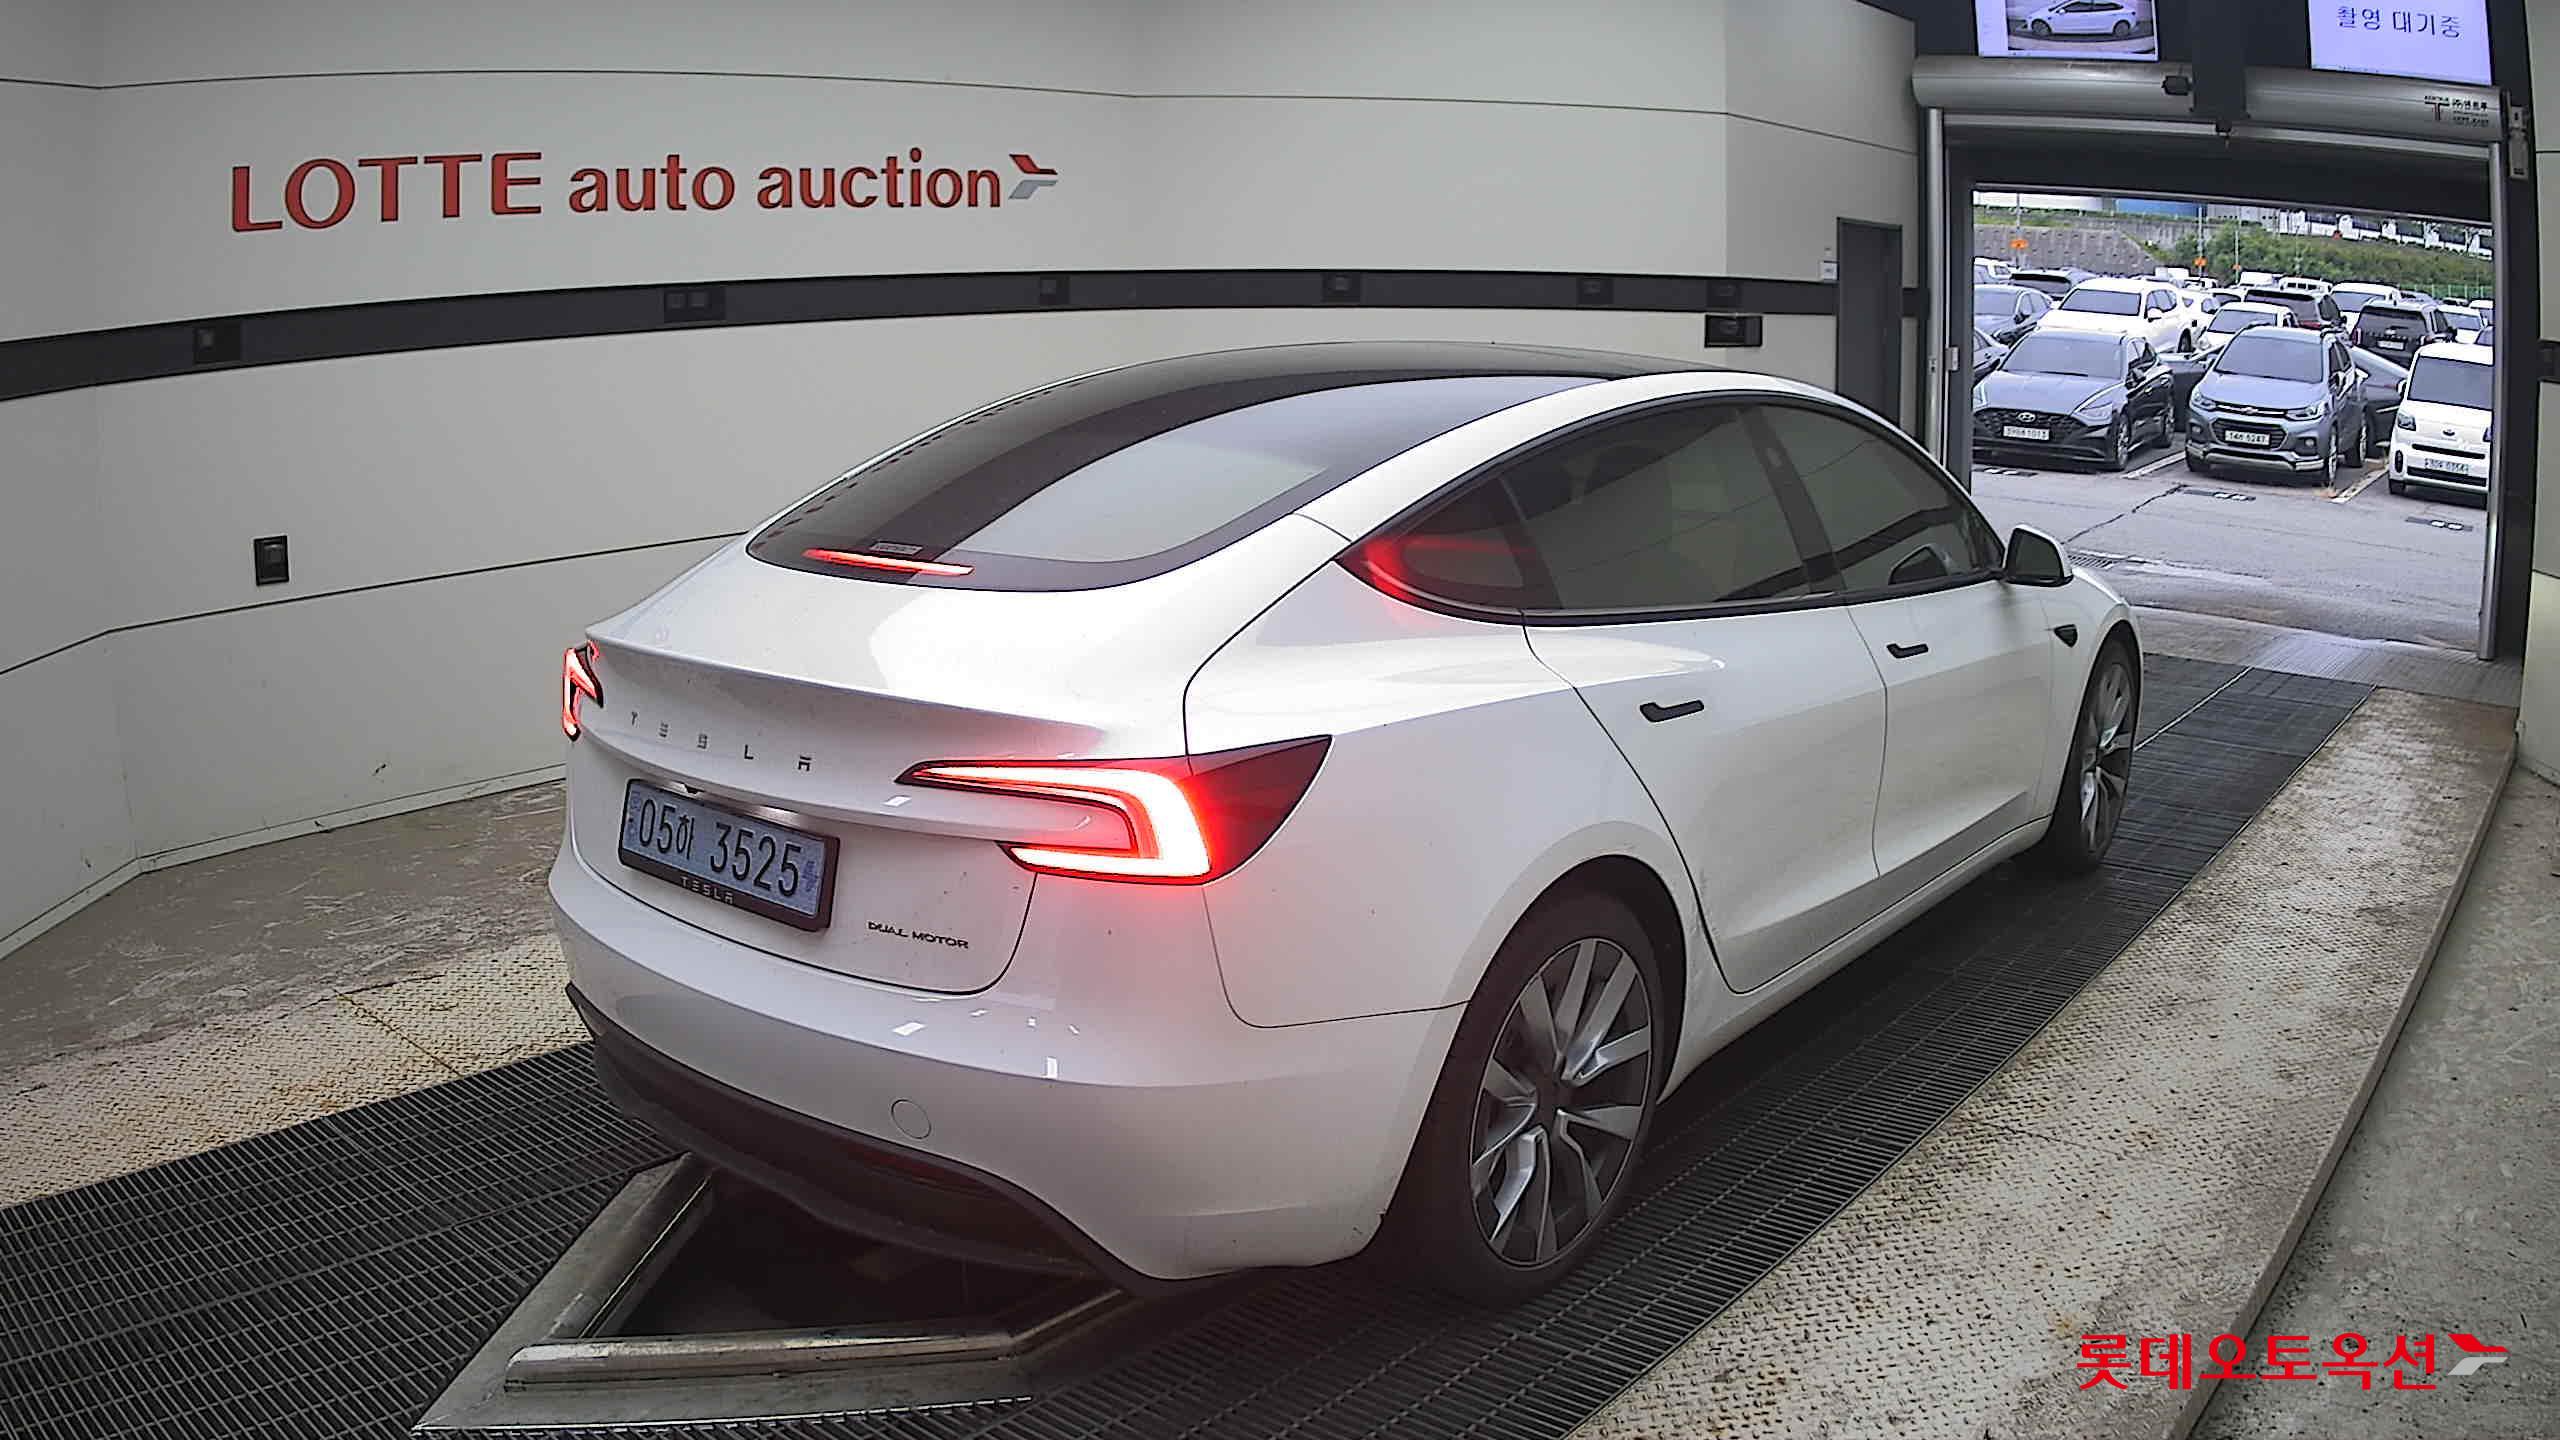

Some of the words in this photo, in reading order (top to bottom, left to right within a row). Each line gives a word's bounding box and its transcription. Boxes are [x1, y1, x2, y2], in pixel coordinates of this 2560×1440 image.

[2337, 6, 2381, 30] 촬영
[2392, 11, 2460, 38] 대기중
[231, 152, 543, 233] LOTTE
[568, 154, 737, 213] auto
[757, 147, 1002, 209] auction
[631, 711, 812, 772] TESLA
[639, 798, 695, 861] 05하
[709, 822, 802, 897] 3525
[680, 876, 734, 905] TESLA
[868, 921, 909, 938] DUAL
[912, 931, 969, 949] MOTOR
